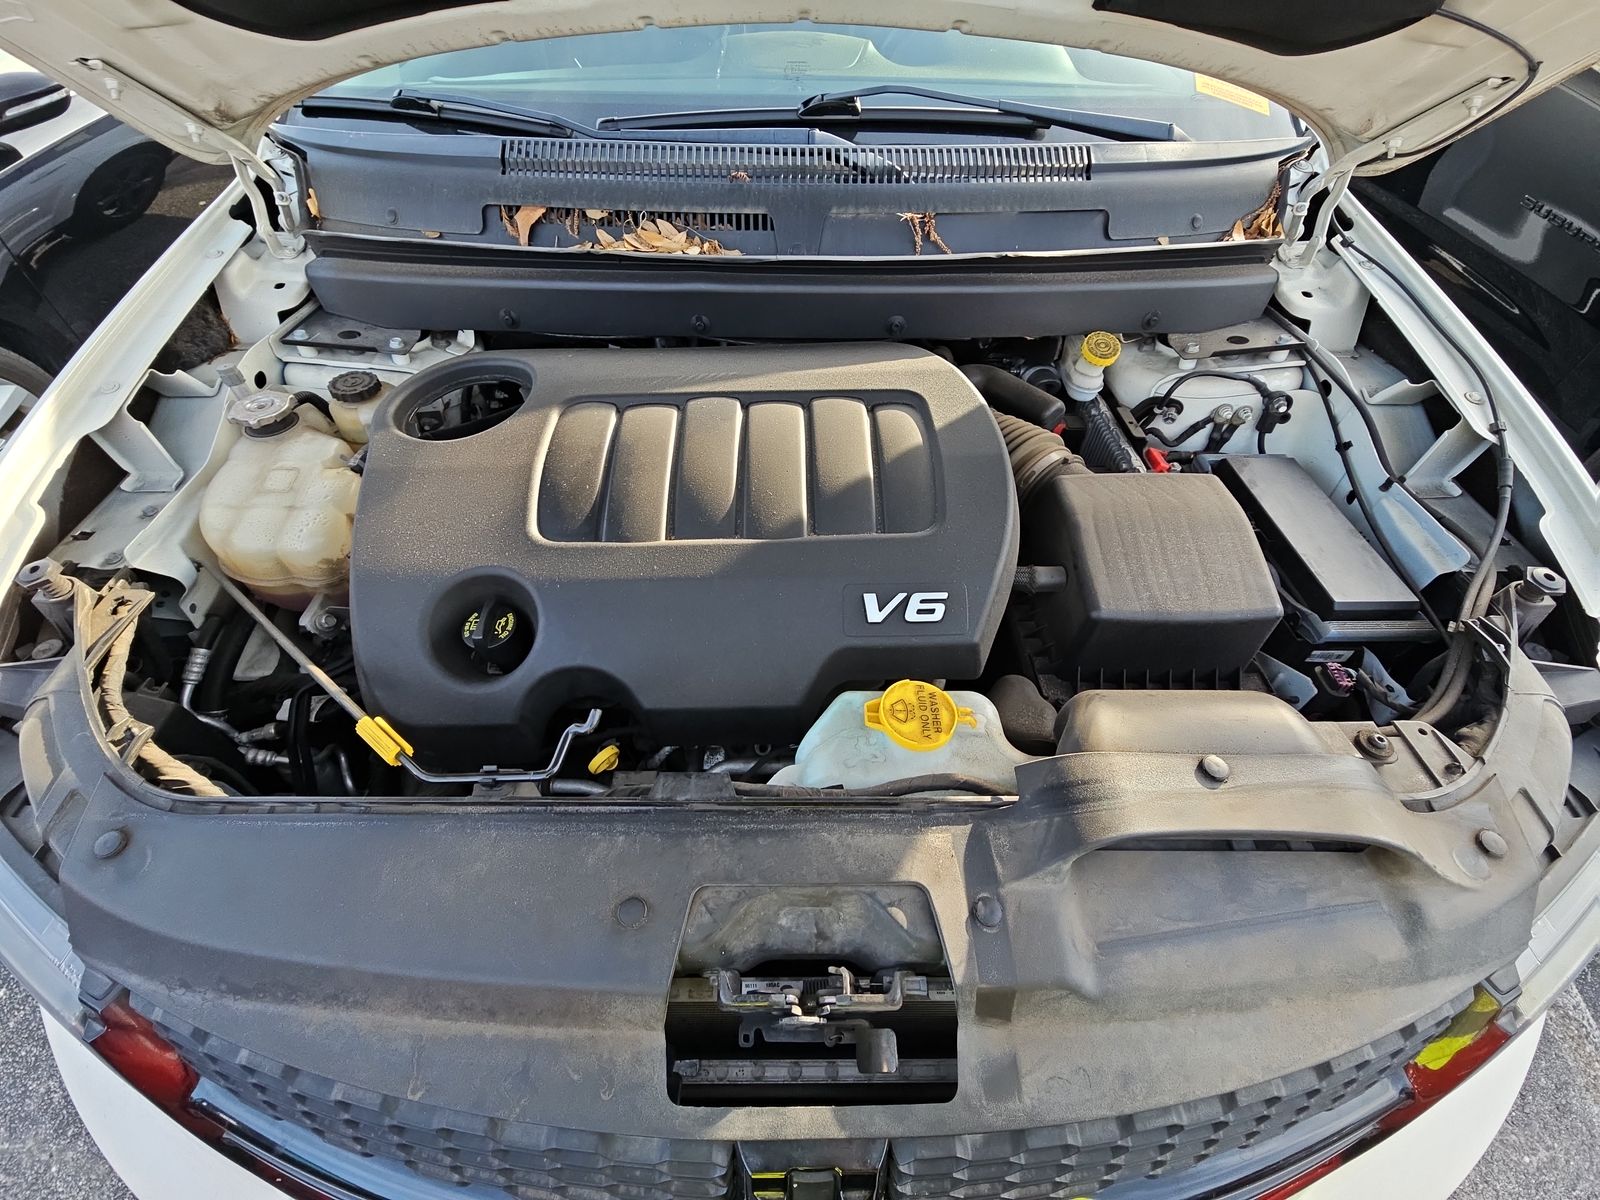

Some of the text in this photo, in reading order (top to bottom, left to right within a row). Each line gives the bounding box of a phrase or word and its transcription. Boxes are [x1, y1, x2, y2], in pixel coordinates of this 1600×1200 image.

[862, 592, 949, 624] V6
[915, 684, 932, 740] FLUID ONLY
[928, 691, 943, 734] WASHER
